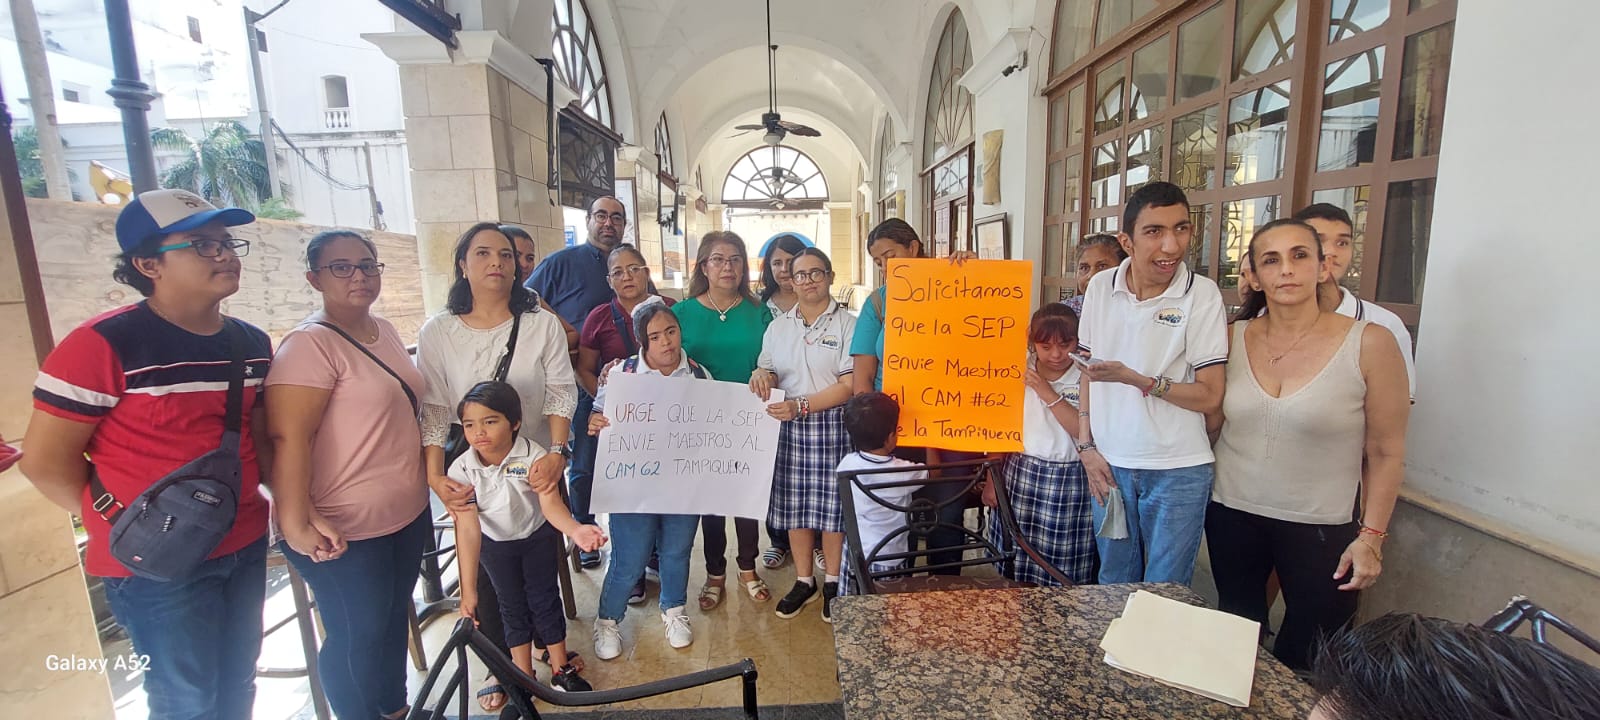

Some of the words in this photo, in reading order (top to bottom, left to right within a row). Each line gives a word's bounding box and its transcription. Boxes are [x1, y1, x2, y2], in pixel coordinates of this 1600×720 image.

[892, 264, 1024, 302] Solicitamos
[891, 316, 926, 337] que
[933, 319, 951, 336] la
[962, 315, 1016, 339] SEP
[887, 354, 935, 371] envie
[945, 358, 1022, 379] Maestros
[921, 387, 961, 408] CAM
[971, 391, 1012, 408] #62
[615, 402, 657, 423] URGE
[667, 403, 697, 425] QUE
[706, 408, 724, 424] LA
[731, 409, 764, 428] SEP
[914, 418, 928, 437] la
[608, 433, 657, 454] ENVIE
[667, 432, 733, 450] MAESTROS
[742, 434, 767, 452] AL
[605, 460, 636, 480] CAM
[640, 460, 661, 476] 62
[673, 458, 751, 476] TAMPIQUERA
